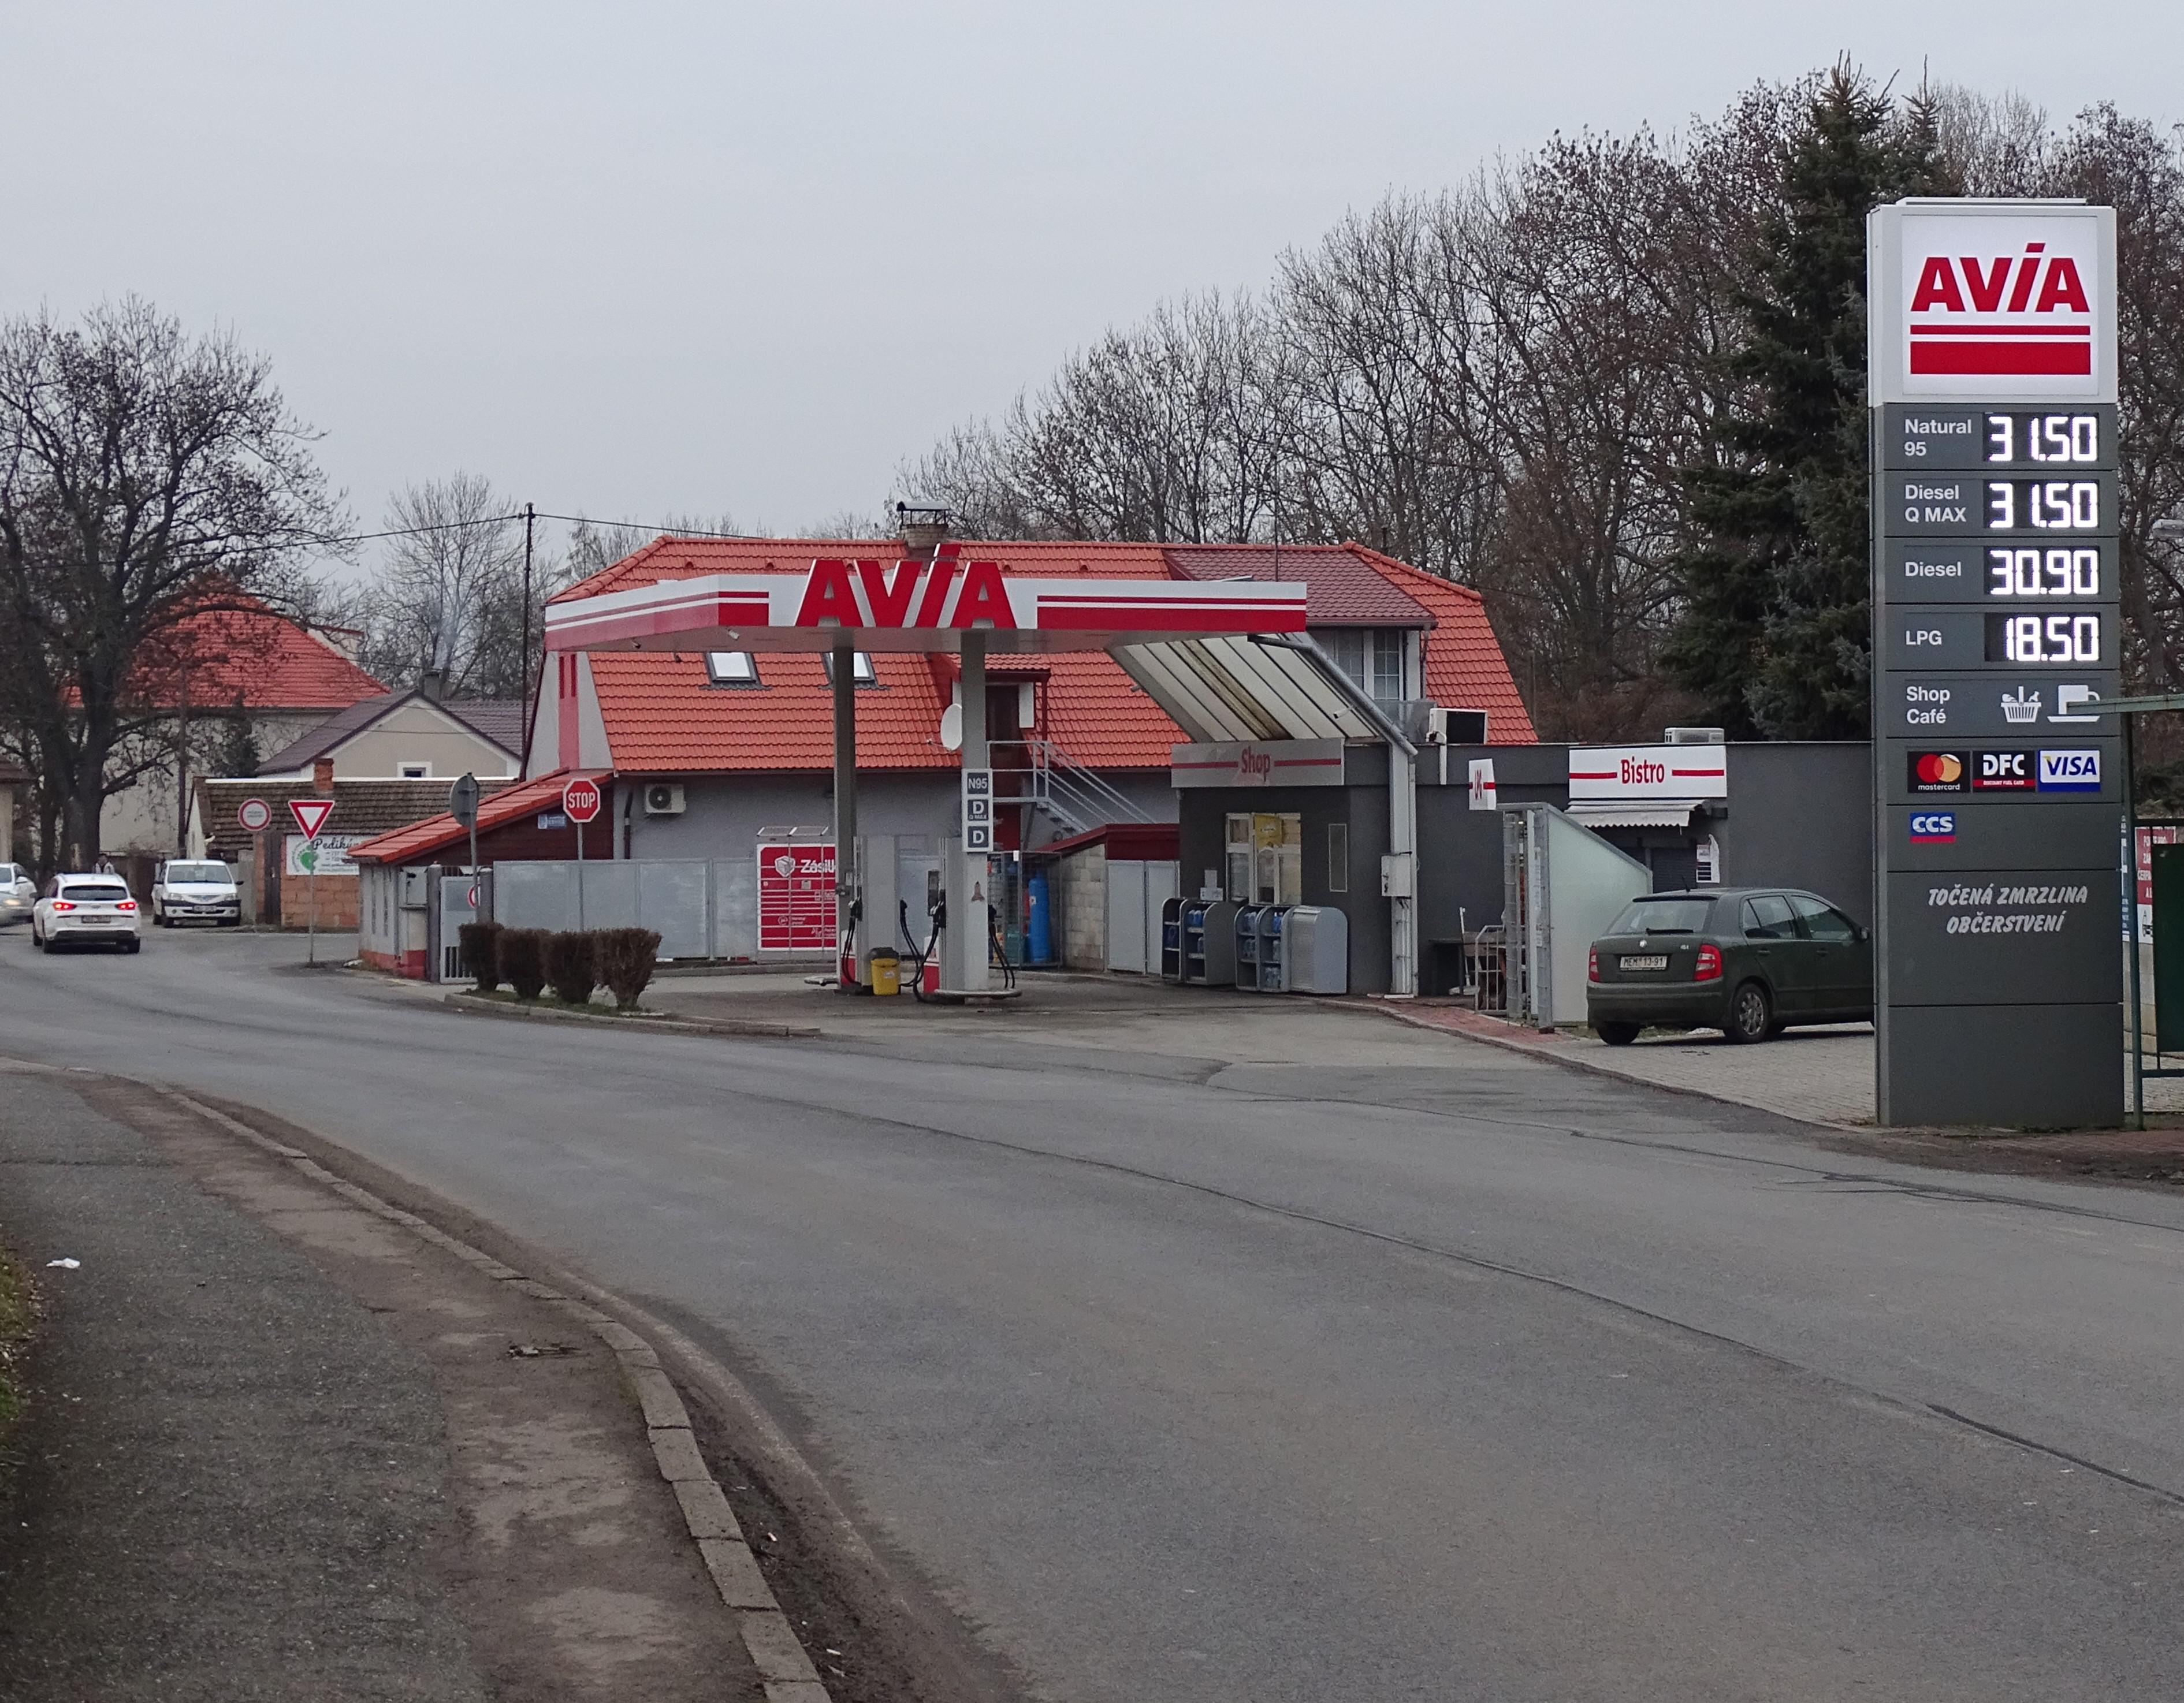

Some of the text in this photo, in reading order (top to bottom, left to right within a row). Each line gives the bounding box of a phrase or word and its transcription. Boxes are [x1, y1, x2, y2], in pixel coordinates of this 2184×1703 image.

[1905, 419, 1971, 434] Natural
[1988, 416, 2097, 462] 31.50
[1904, 441, 1927, 456] 95
[1905, 485, 1959, 500] Diesel
[1988, 482, 2099, 528] 31.50
[1905, 507, 1966, 523] Q MAX
[1905, 562, 1962, 577] Diesel
[1989, 550, 2099, 595] 30.90
[1906, 631, 1943, 646] LPG
[2005, 616, 2100, 662] 18.50
[1906, 686, 1951, 704] Shop
[1906, 709, 1947, 724] Café
[1241, 746, 1270, 782] Shop
[1620, 755, 1665, 784] Bistro
[1983, 754, 2025, 776] DFC
[2042, 755, 2097, 776] VISA
[968, 777, 988, 789] N95
[1918, 783, 1960, 791] mastercard
[568, 792, 596, 808] STOP
[973, 800, 984, 814] D
[1912, 816, 1954, 833] CCS
[972, 830, 984, 844] D
[1928, 883, 2088, 906] TOČENÁ ZMRZLINA
[1946, 910, 2067, 934] OBČERSTVENÍ
